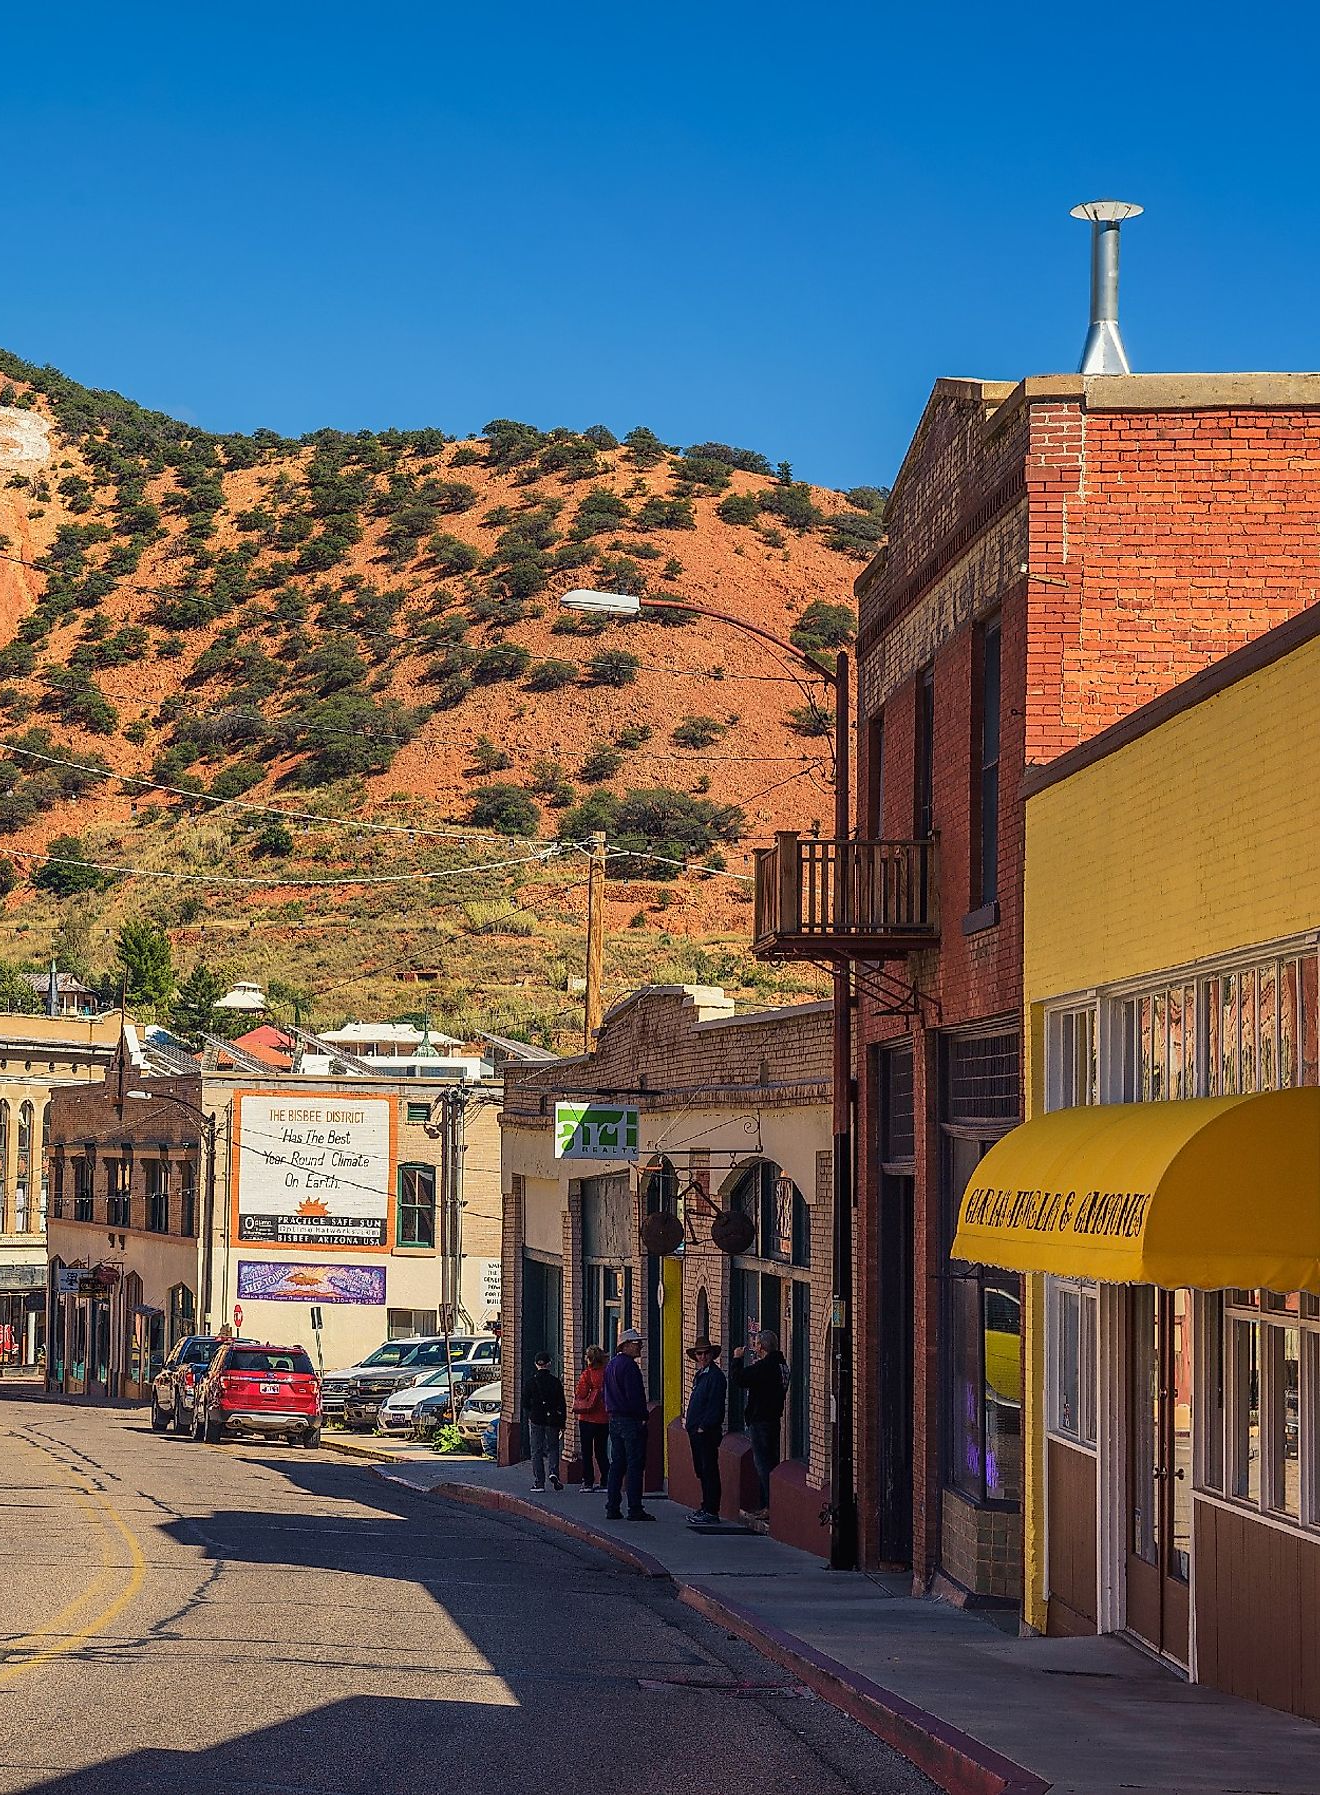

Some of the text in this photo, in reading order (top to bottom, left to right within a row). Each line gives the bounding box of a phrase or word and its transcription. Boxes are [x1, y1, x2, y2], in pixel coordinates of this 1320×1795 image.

[269, 1109, 365, 1124] THE BISBEE DISTRICT
[305, 1129, 325, 1144] The
[327, 1129, 351, 1144] Best
[582, 1146, 637, 1155] REALTY
[291, 1151, 326, 1166] Round
[331, 1152, 370, 1167] Climate
[285, 1172, 299, 1188] On
[1059, 1190, 1076, 1232] &
[277, 1216, 381, 1228] PRACTICE SAFE SUN
[318, 1236, 359, 1245] ARIZONA
[363, 1237, 380, 1246] USA
[244, 1266, 289, 1294] JEEP TOURS
